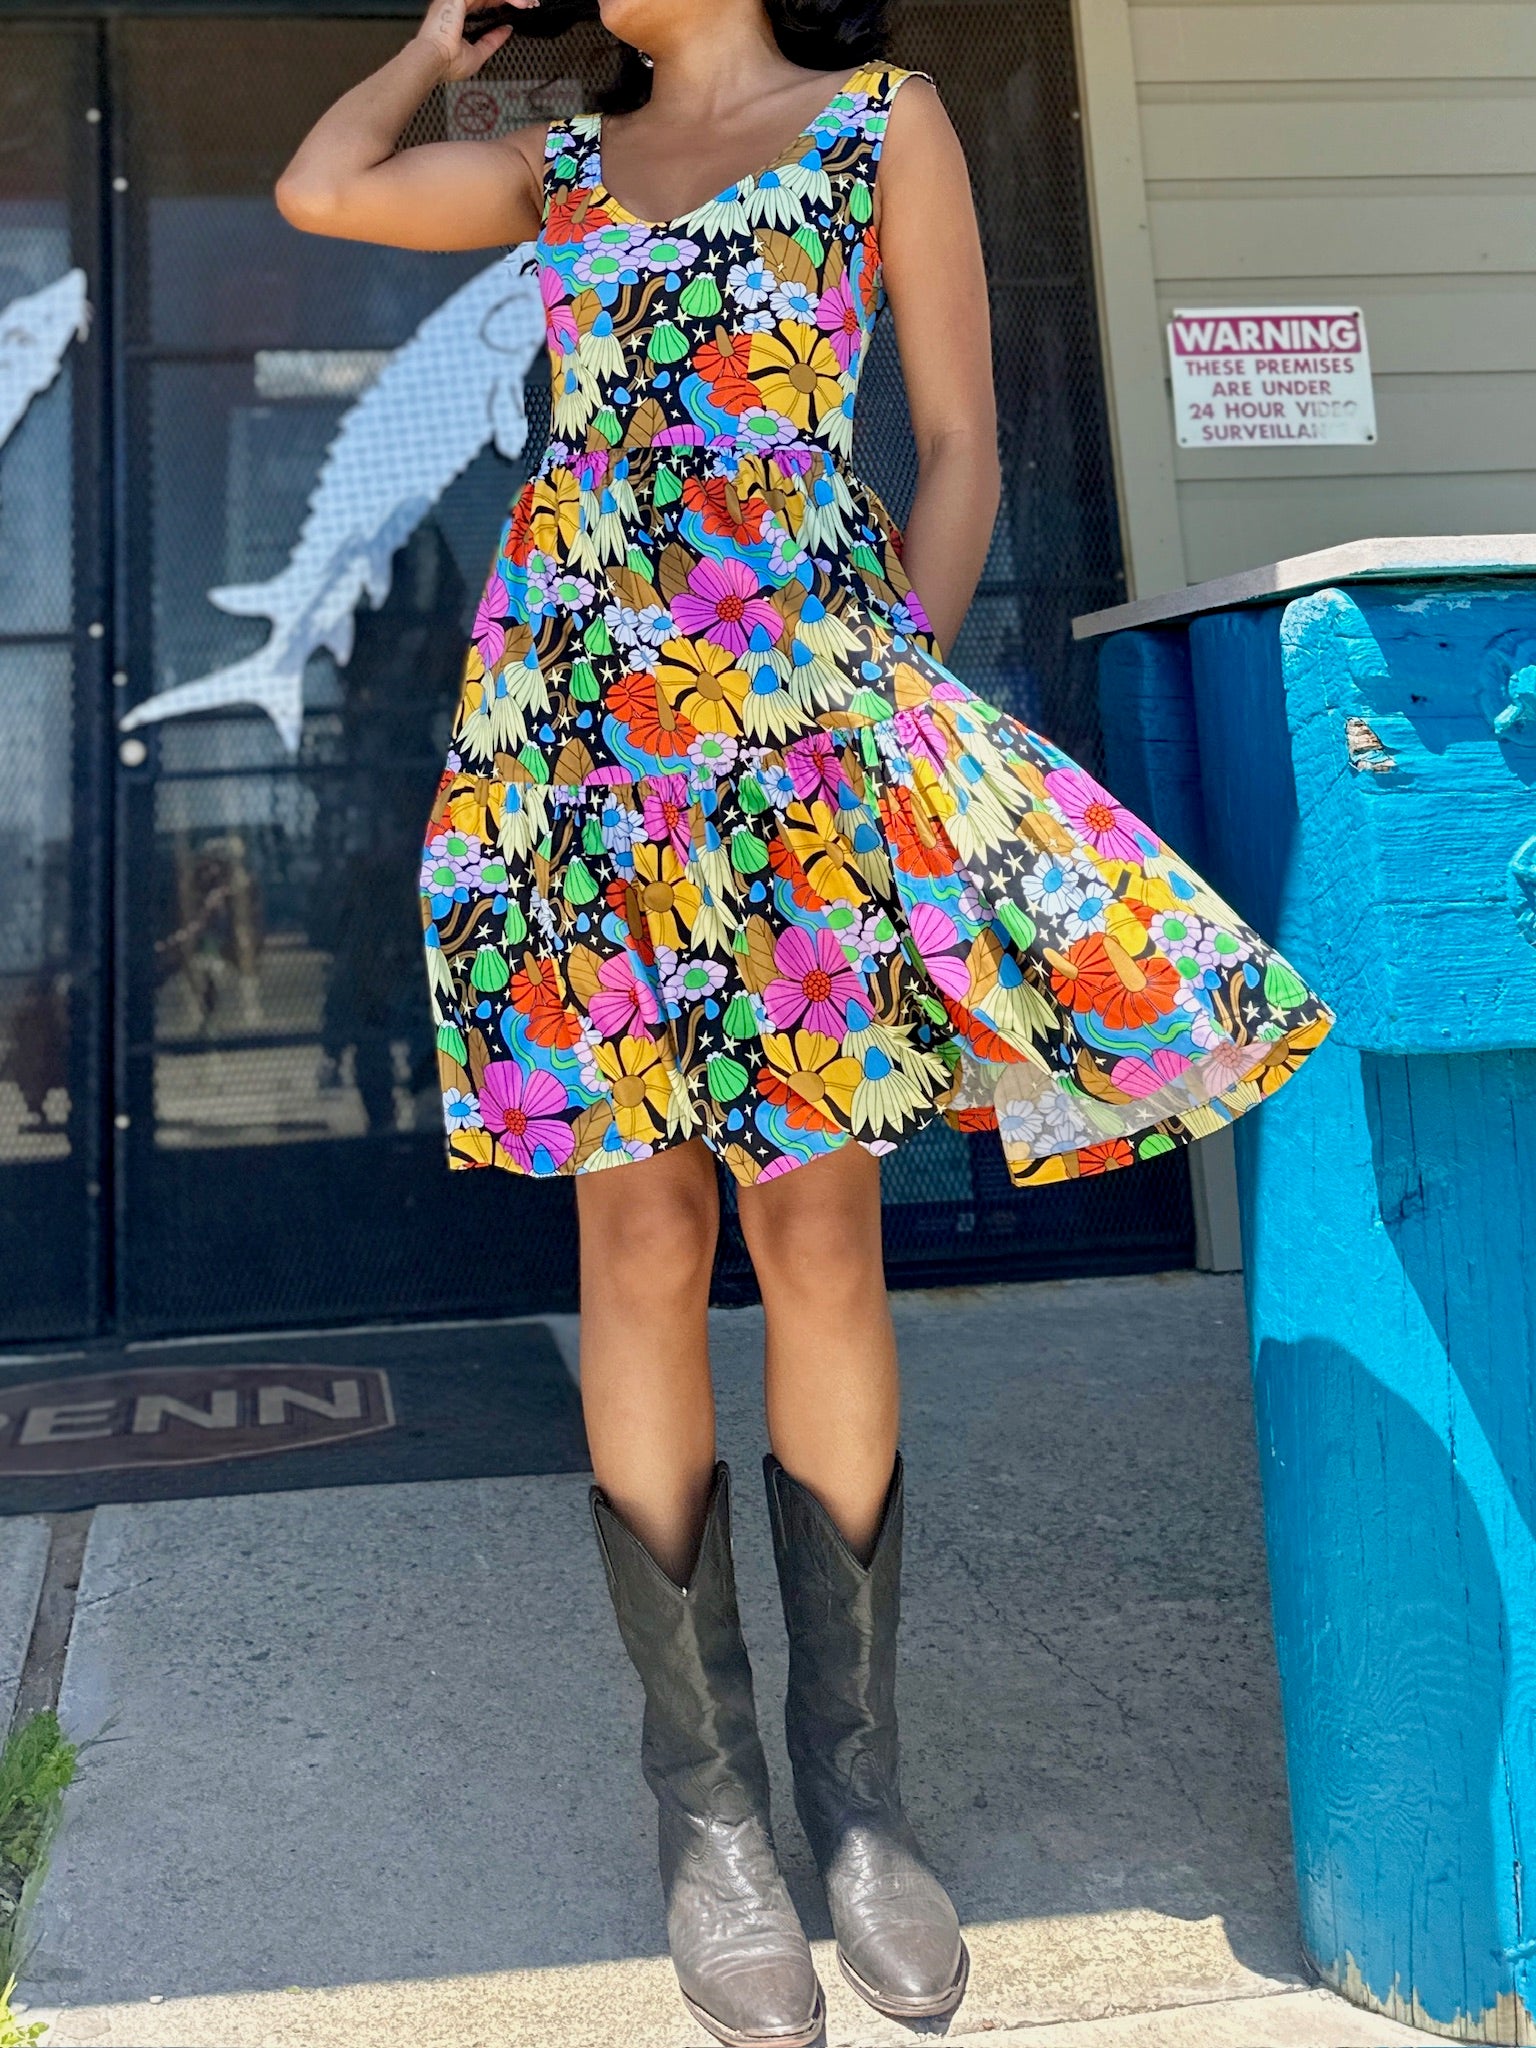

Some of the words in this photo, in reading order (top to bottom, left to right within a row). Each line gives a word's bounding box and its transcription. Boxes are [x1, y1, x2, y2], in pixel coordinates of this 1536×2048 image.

[1176, 319, 1357, 352] WARNING
[1186, 360, 1245, 376] THESE
[1255, 358, 1354, 375] PREMISES
[1212, 381, 1252, 397] ARE
[1262, 380, 1331, 396] UNDER
[1189, 403, 1214, 420] 24
[1225, 402, 1285, 419] HOUR
[1296, 401, 1357, 418] VIDEO
[0, 1380, 360, 1445] ENN
